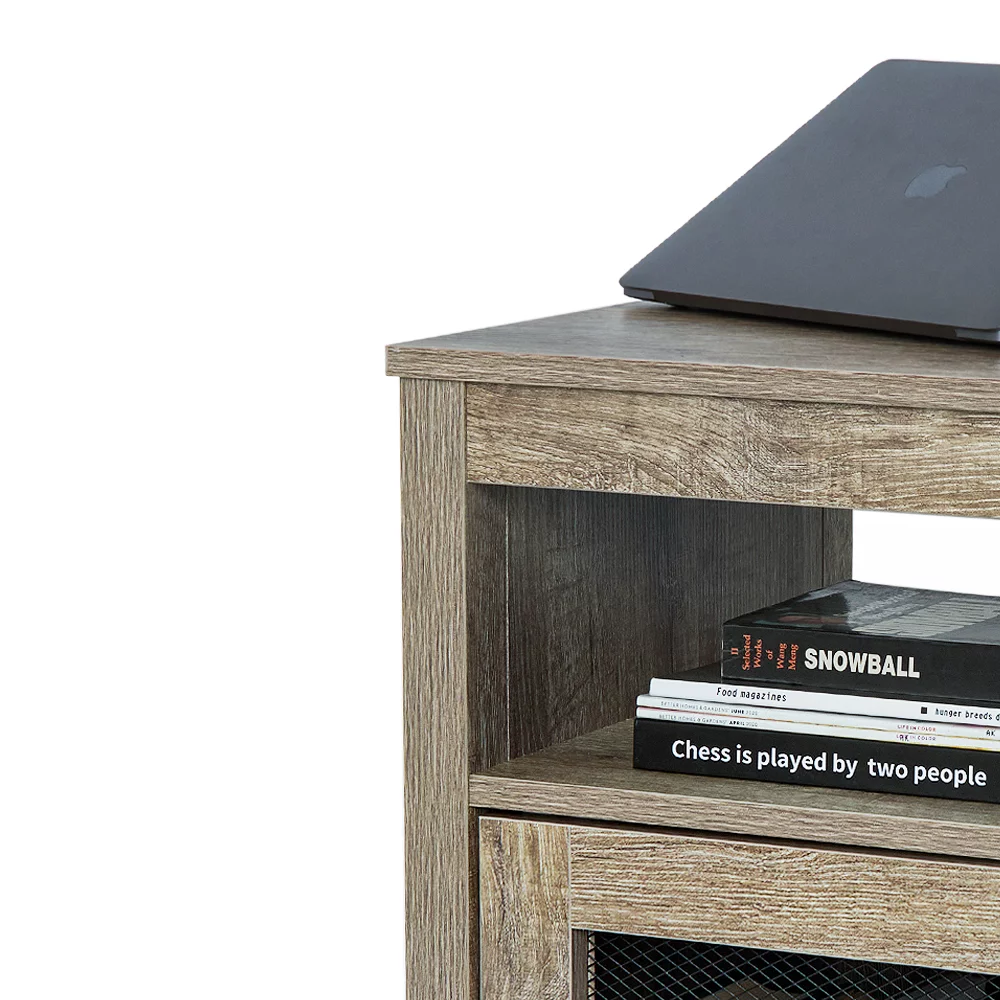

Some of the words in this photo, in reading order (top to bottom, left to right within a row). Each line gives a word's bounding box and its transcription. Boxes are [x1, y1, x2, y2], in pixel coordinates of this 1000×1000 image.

[741, 634, 751, 671] Selected
[753, 638, 763, 669] Works
[766, 649, 774, 661] of
[776, 642, 788, 670] Wang
[788, 643, 800, 671] Meng
[804, 647, 921, 679] SNOWBALL
[716, 687, 738, 698] Food
[740, 690, 787, 702] magazines
[935, 708, 962, 719] hunger
[965, 711, 993, 721] breeds
[671, 739, 731, 763] Chess
[736, 743, 752, 764] is
[757, 747, 827, 773] played
[832, 753, 858, 779] by
[867, 758, 909, 779] two
[913, 764, 988, 789] people
